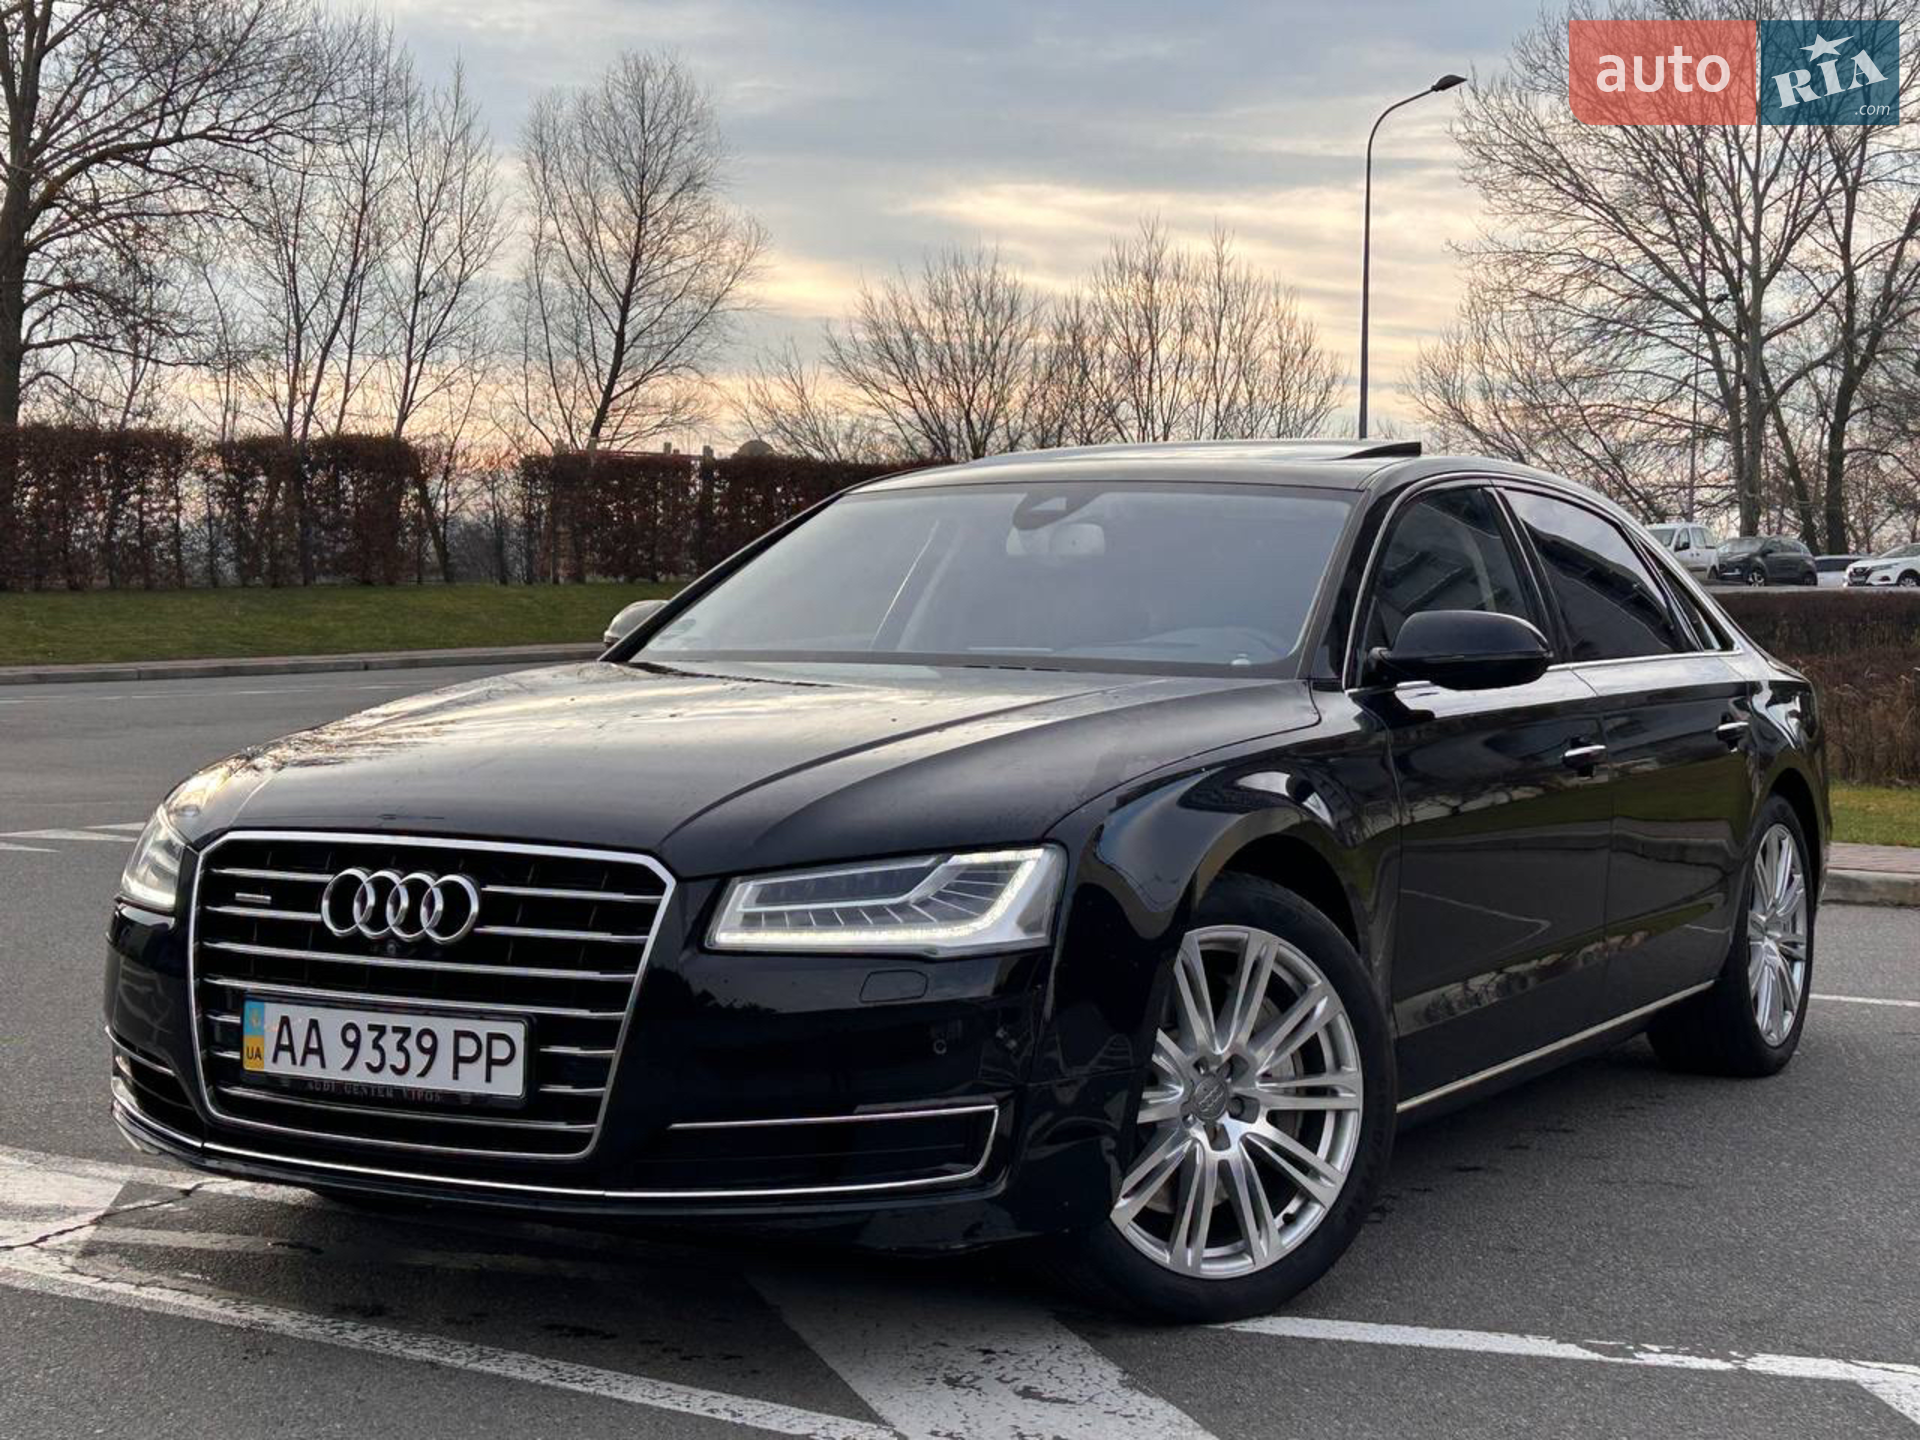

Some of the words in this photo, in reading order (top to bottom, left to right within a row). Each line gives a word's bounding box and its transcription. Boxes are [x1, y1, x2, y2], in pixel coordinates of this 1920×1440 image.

[246, 1046, 262, 1061] UA
[272, 1015, 327, 1069] AA
[340, 1021, 439, 1079] 9339
[452, 1029, 516, 1083] PP
